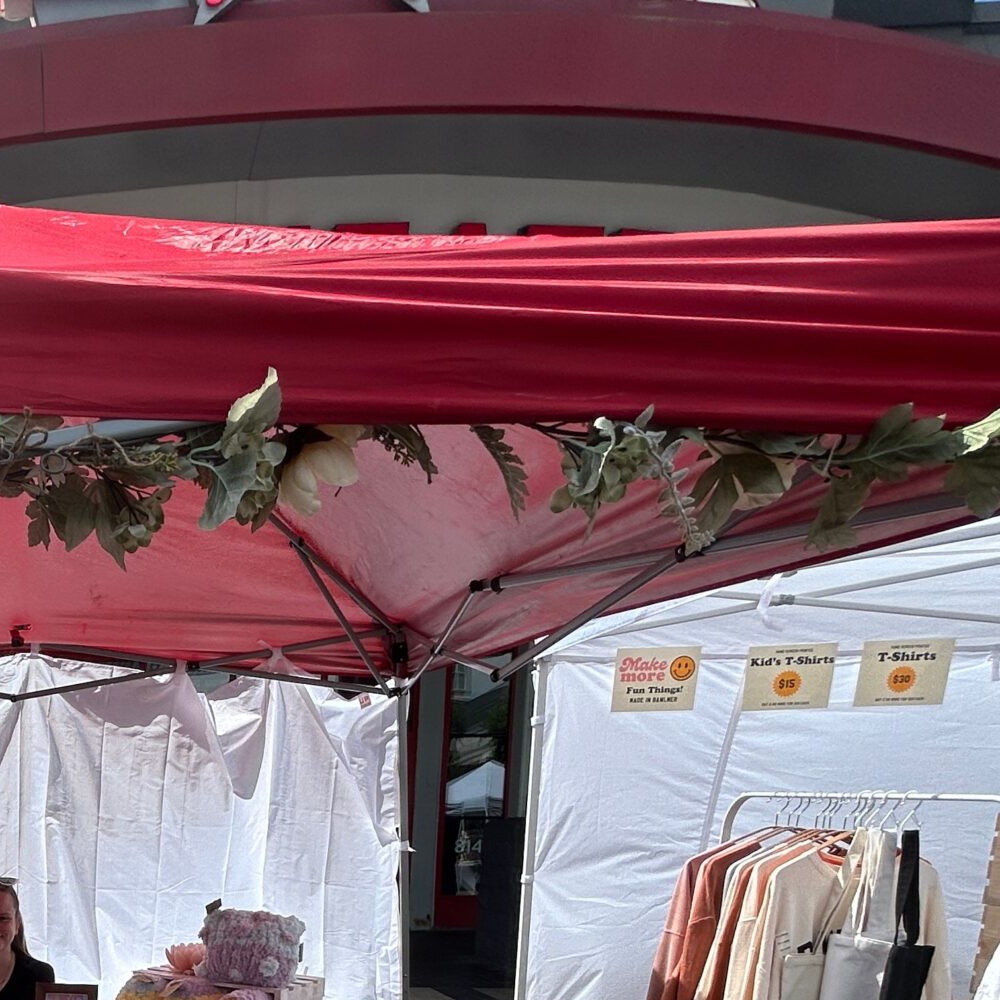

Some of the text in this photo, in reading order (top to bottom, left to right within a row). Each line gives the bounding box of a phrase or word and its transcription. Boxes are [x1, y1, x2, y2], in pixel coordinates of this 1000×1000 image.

[750, 655, 835, 667] Kid's T-Shirts
[878, 651, 937, 662] T-Shirts
[619, 656, 669, 672] Make
[620, 672, 665, 682] more
[893, 674, 911, 684] $30
[778, 678, 796, 689] $15
[648, 686, 684, 695] Things!
[454, 839, 483, 854] 814
